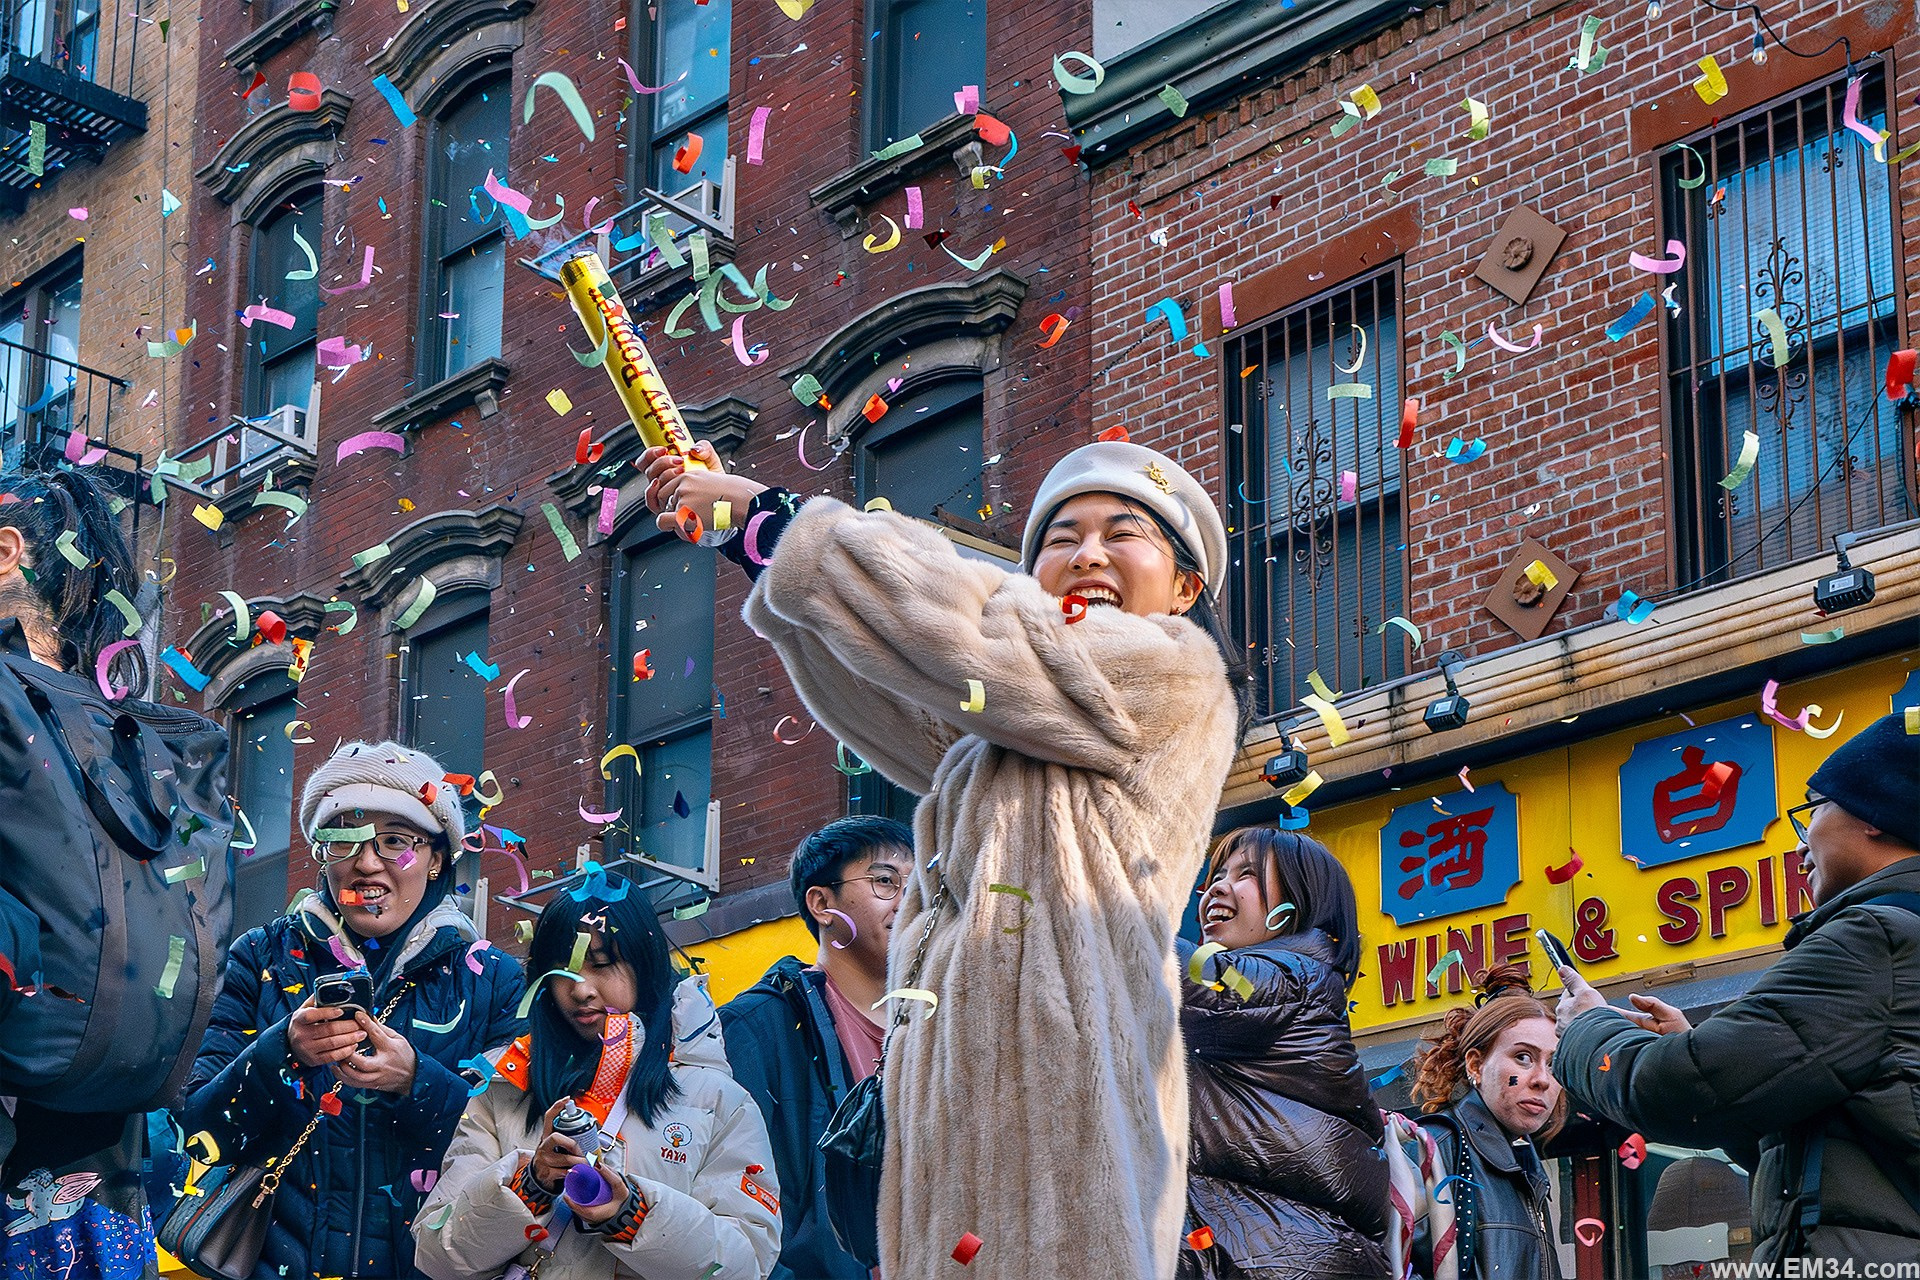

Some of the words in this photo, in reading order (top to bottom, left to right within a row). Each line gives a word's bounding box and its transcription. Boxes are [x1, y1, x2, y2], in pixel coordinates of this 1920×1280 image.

[587, 286, 655, 389] Popper
[1399, 804, 1495, 900] 酒
[1652, 745, 1743, 844] 白
[1377, 913, 1532, 1007] WINE
[1573, 896, 1619, 964] &
